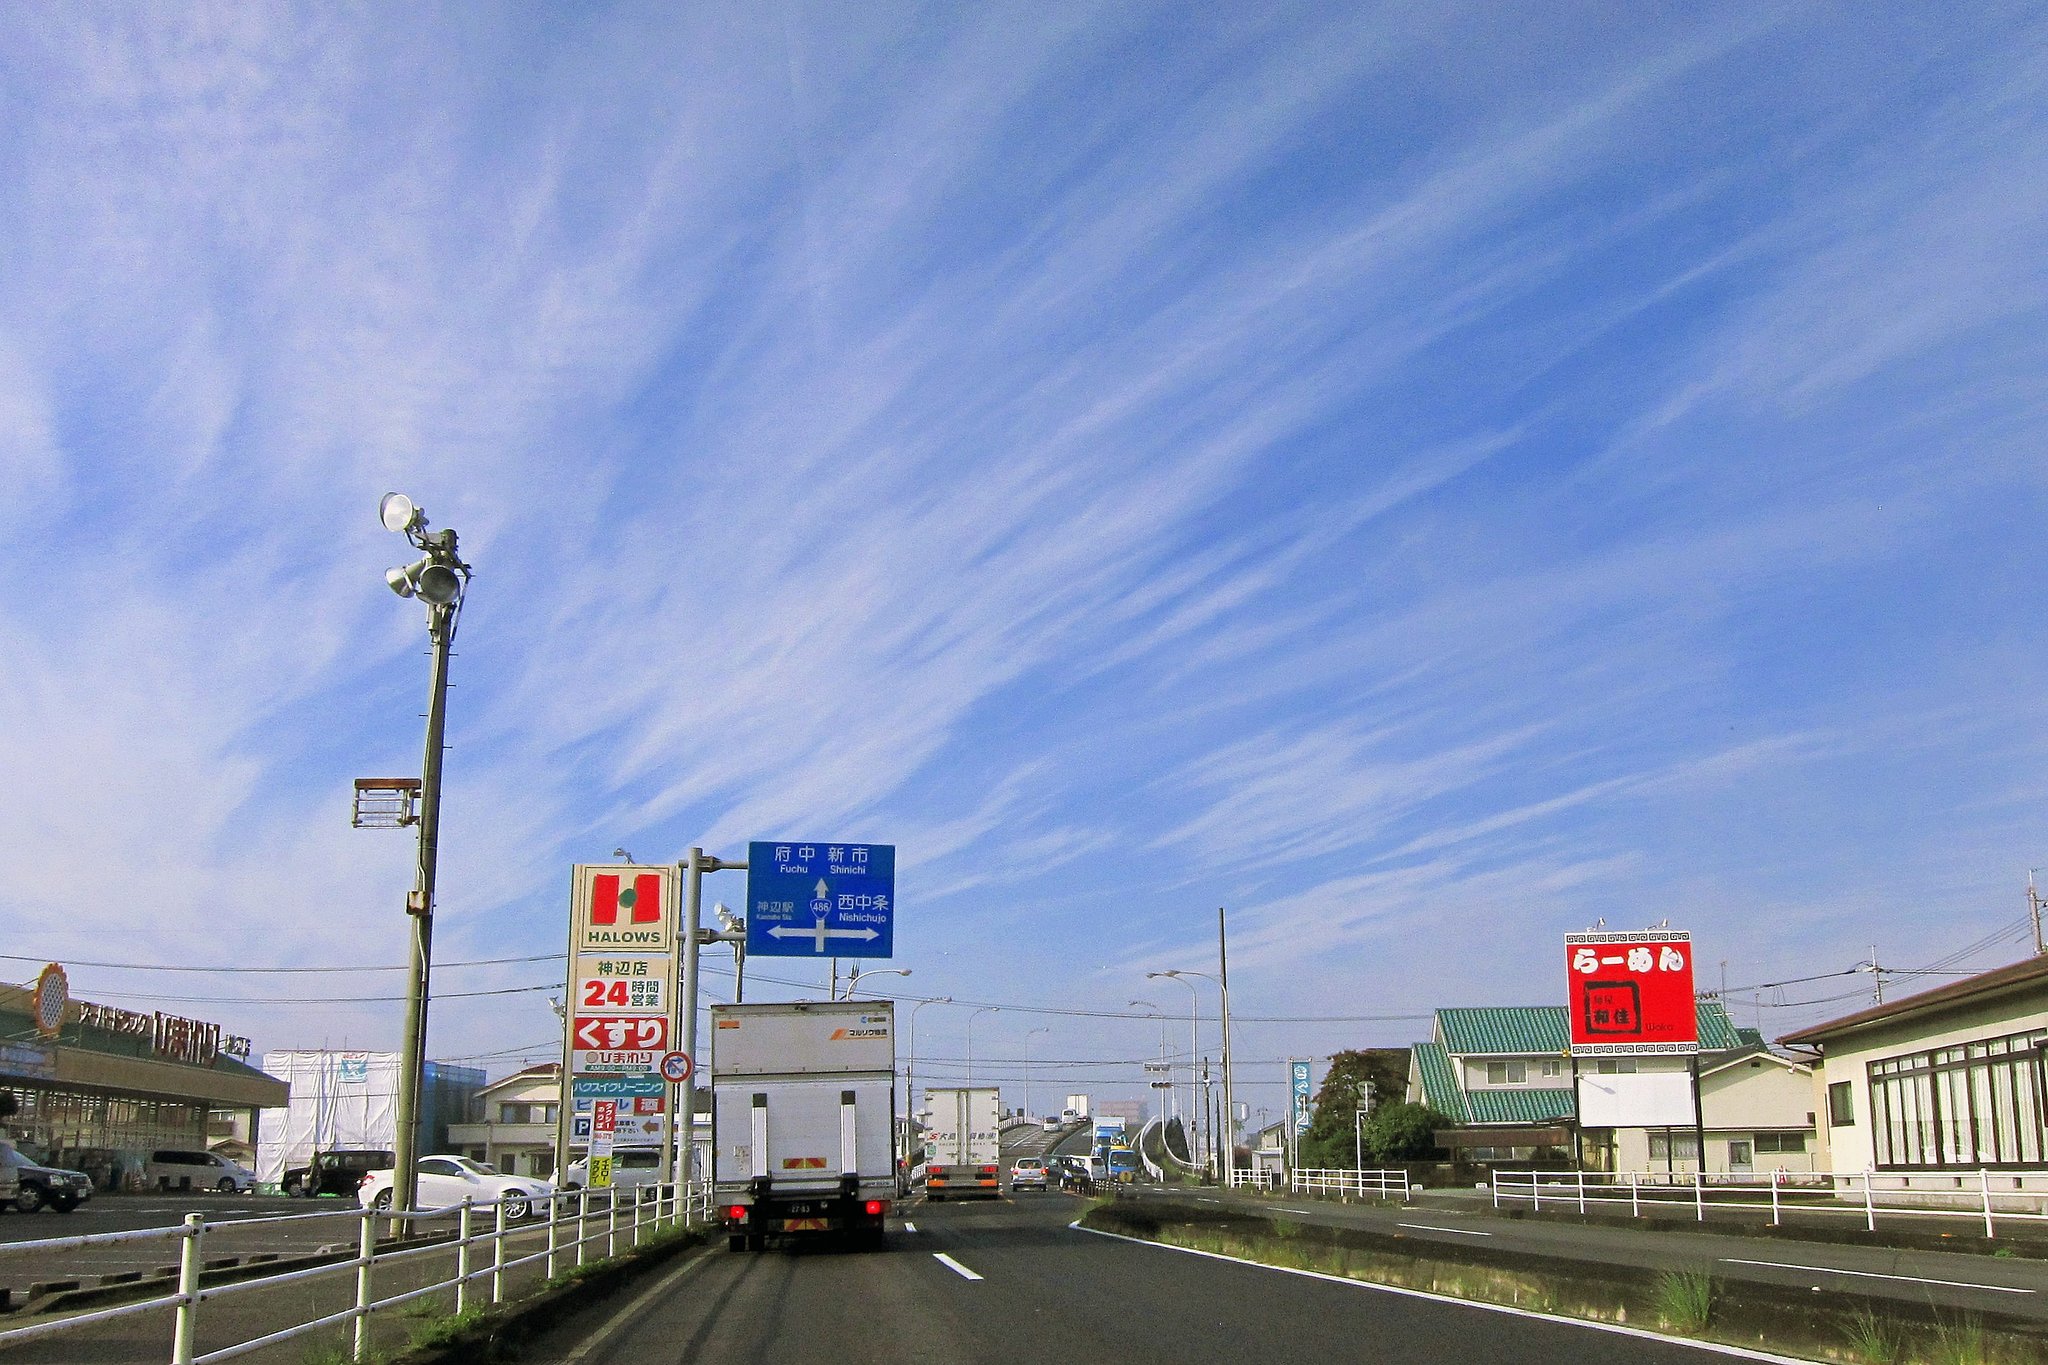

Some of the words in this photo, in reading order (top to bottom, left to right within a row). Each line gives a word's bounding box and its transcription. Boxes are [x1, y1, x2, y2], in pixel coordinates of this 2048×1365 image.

[775, 846, 816, 862] 府中
[828, 847, 869, 863] 新市
[780, 864, 808, 874] Fuchu
[830, 865, 866, 875] Shinichi
[813, 903, 829, 911] 486
[838, 894, 889, 911] 西中条
[839, 913, 887, 924] Nishichujo
[588, 931, 660, 943] HALOWS
[1573, 946, 1684, 974] らーめん
[598, 961, 648, 976] 神辺店
[631, 980, 659, 993] 時間
[584, 980, 629, 1007] 24
[631, 994, 659, 1007] 営業
[578, 1019, 663, 1048] くすり
[599, 1052, 653, 1064] ひまわり
[573, 1082, 664, 1093] ハクスイクリーニング
[605, 1103, 613, 1129] タクシー
[578, 1121, 589, 1135] P
